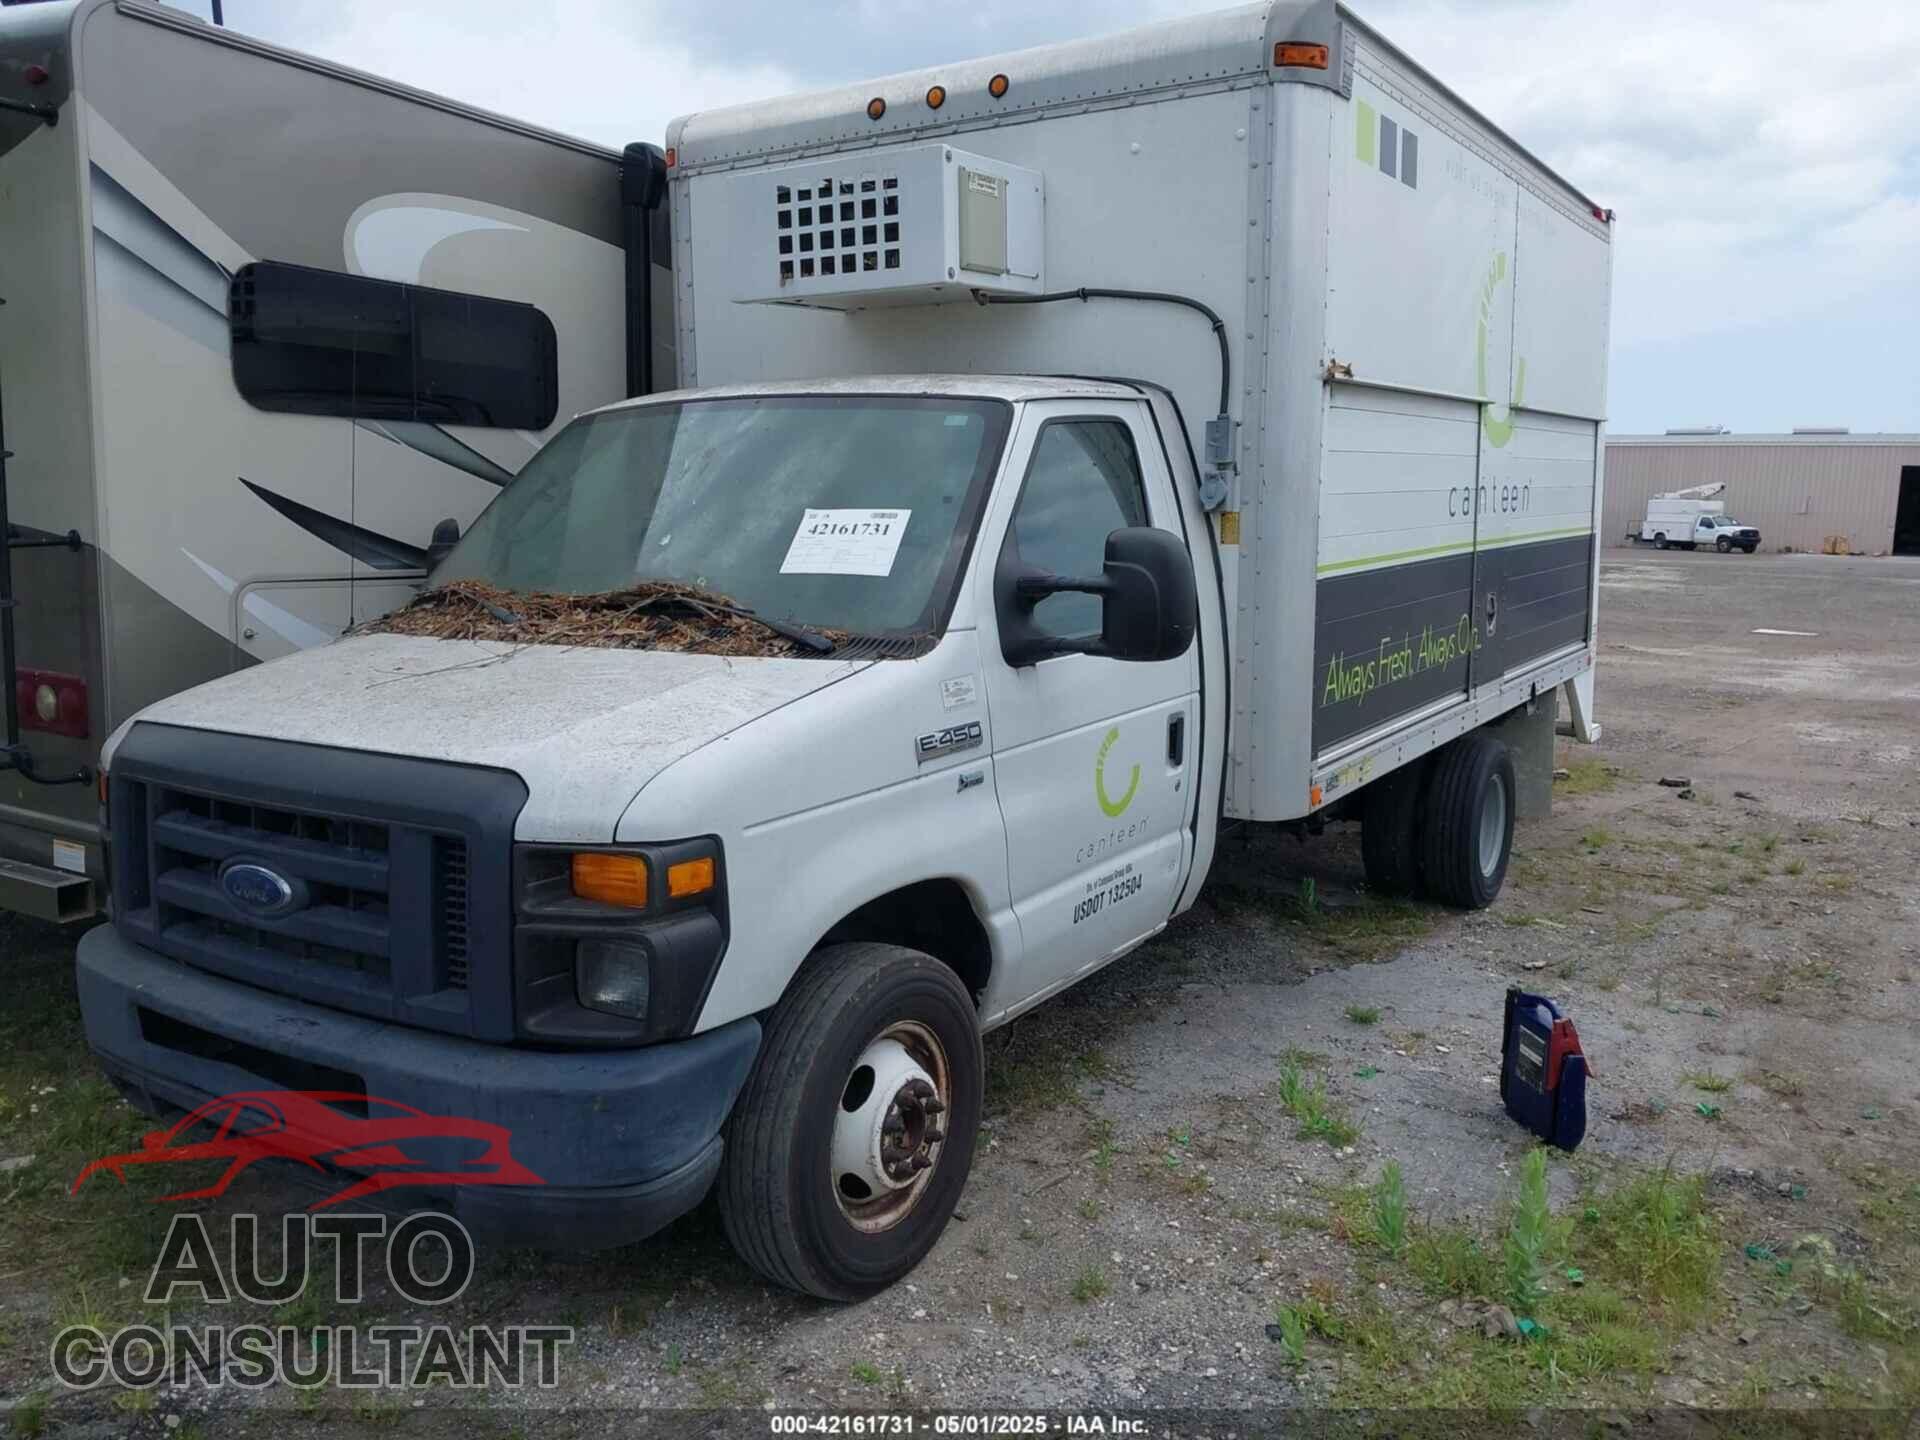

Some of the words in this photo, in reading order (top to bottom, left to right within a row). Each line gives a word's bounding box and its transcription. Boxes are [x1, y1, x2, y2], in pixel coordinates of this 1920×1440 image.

[1448, 476, 1530, 517] canteen
[807, 523, 891, 536] 42161731
[1323, 651, 1375, 707] Always
[1416, 624, 1455, 672] Always
[1076, 819, 1147, 863] canteen
[1073, 891, 1105, 924] USDOT
[1108, 873, 1143, 905] 132504
